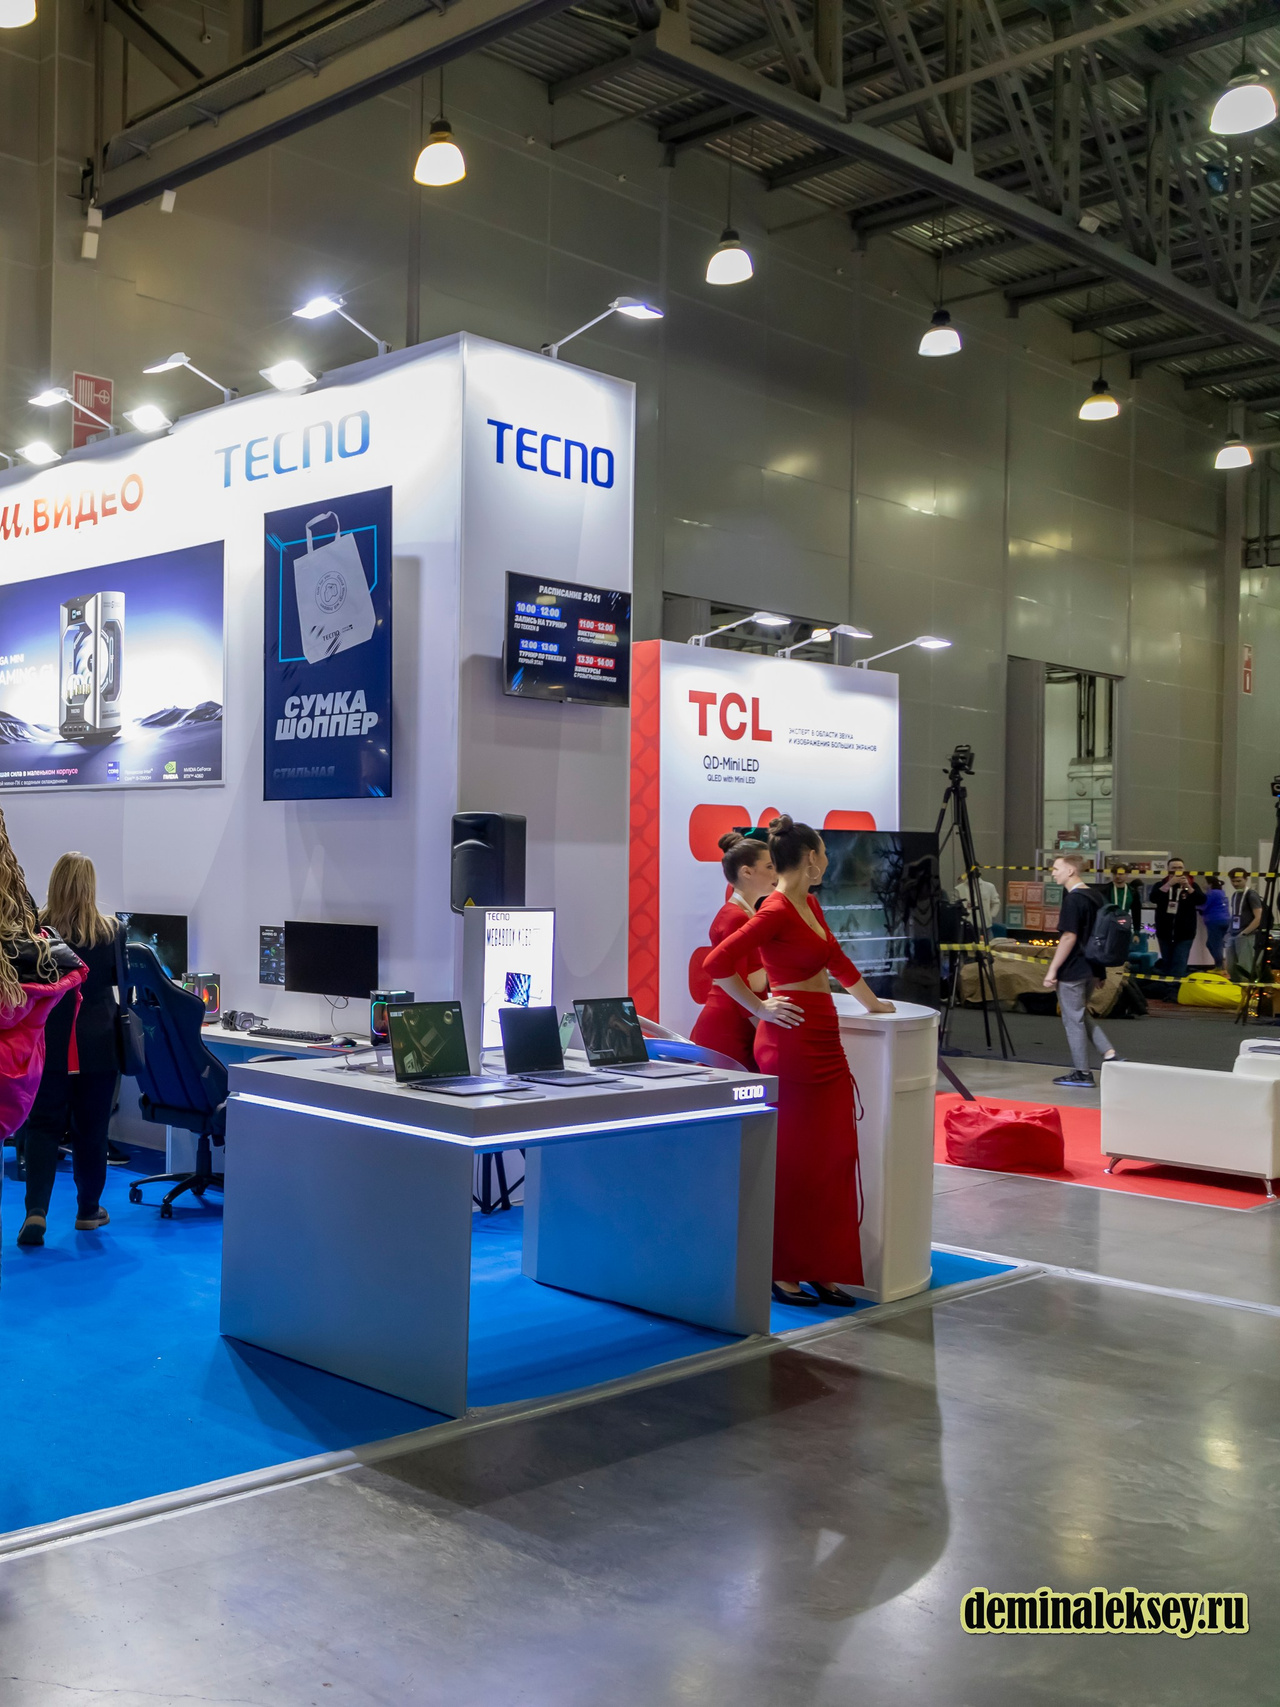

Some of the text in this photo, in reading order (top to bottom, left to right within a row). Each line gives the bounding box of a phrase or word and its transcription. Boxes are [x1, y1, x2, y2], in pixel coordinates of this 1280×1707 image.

[214, 410, 370, 488] TECNO
[487, 418, 614, 489] TECNO
[539, 585, 601, 603] РАСПИСАНИЕ 29.11
[514, 614, 537, 624] ЗАПИСЬ
[579, 620, 594, 629] 11:00
[598, 623, 613, 632] 12:00
[9, 654, 24, 664] MINI
[284, 690, 367, 718] СУМКА
[689, 690, 772, 742] TCL
[275, 712, 379, 741] ШОППЕР
[816, 730, 838, 738] ОБЛАСТИ
[793, 738, 830, 747] ИЗОБРАЖЕНИЯ
[831, 741, 854, 750] БОЛЬШИХ
[855, 743, 877, 751] ЭКРАНОВ
[56, 768, 78, 776] корпусе
[273, 766, 335, 779] СТИЛЬНАЯ
[707, 774, 722, 782] QLED
[723, 775, 734, 783] with
[745, 776, 756, 784] LED
[487, 913, 510, 921] TECNO
[732, 1085, 764, 1100] TECNO
